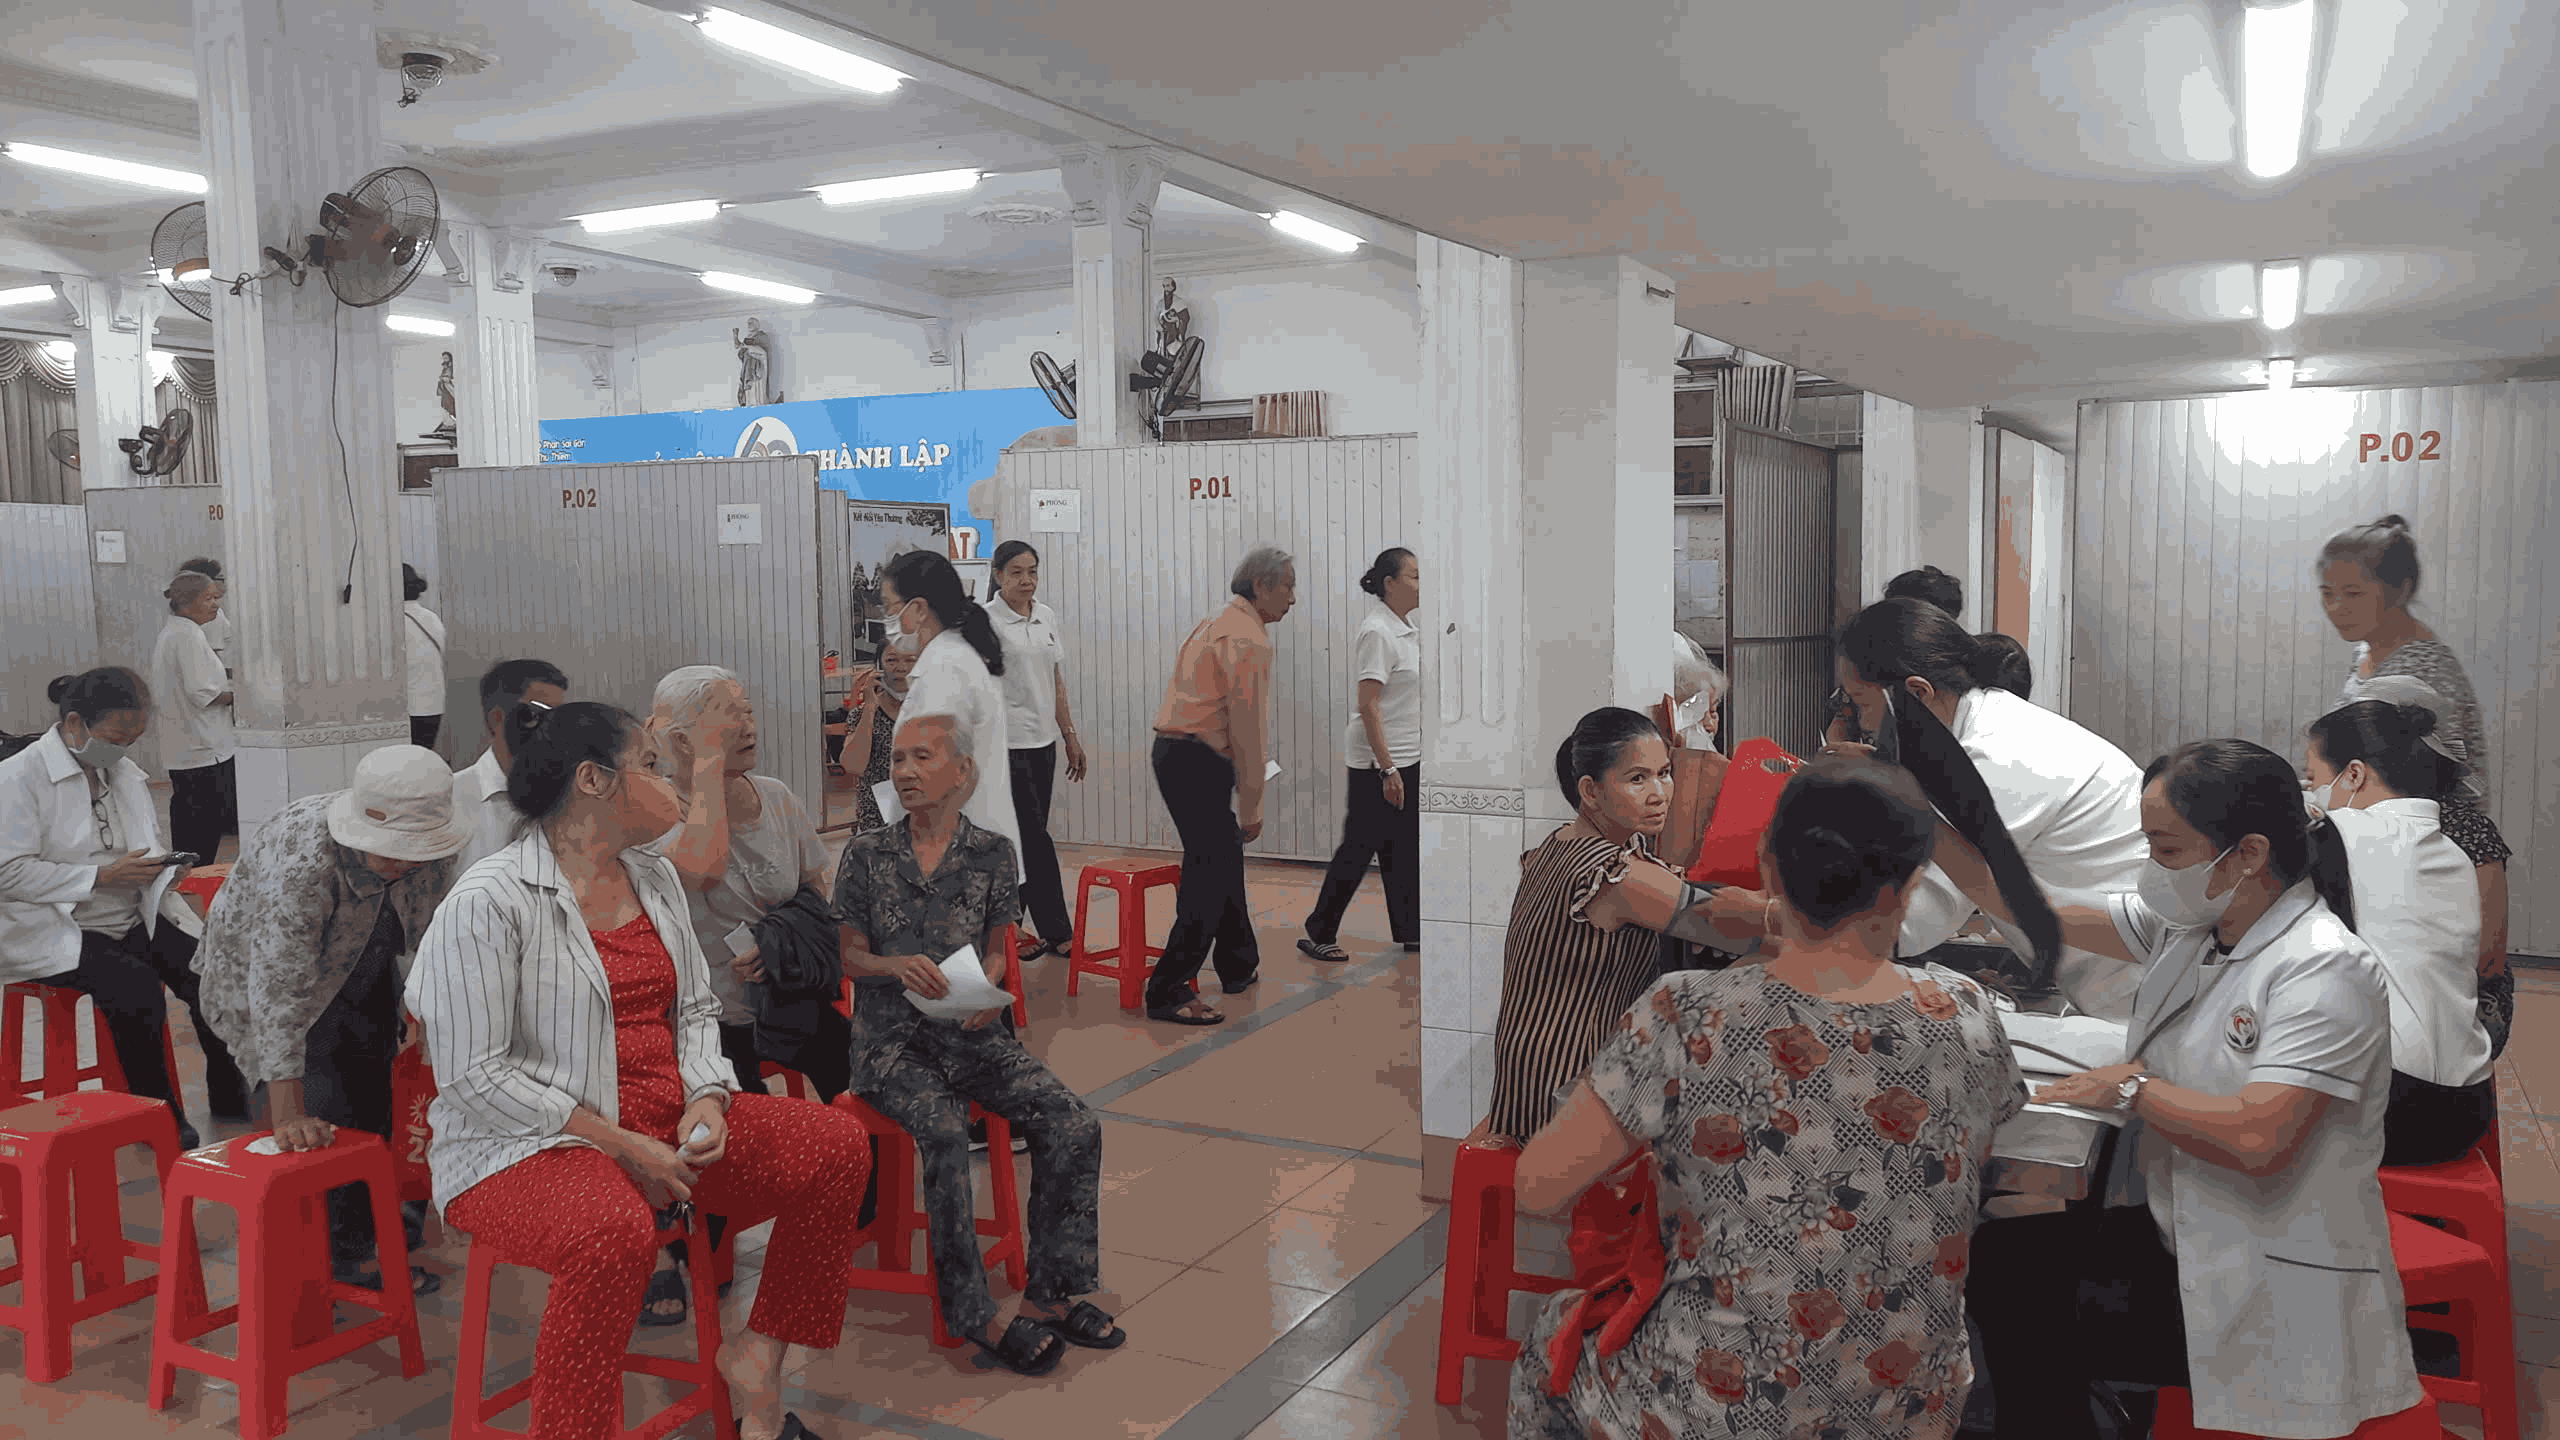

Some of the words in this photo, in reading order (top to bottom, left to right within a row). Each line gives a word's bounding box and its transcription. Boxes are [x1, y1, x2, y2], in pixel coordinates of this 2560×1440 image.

[900, 438, 950, 472] LẬP
[2359, 430, 2442, 463] P.02
[563, 488, 597, 508] P.02
[1189, 475, 1231, 499] P.01
[208, 504, 224, 520] P.0
